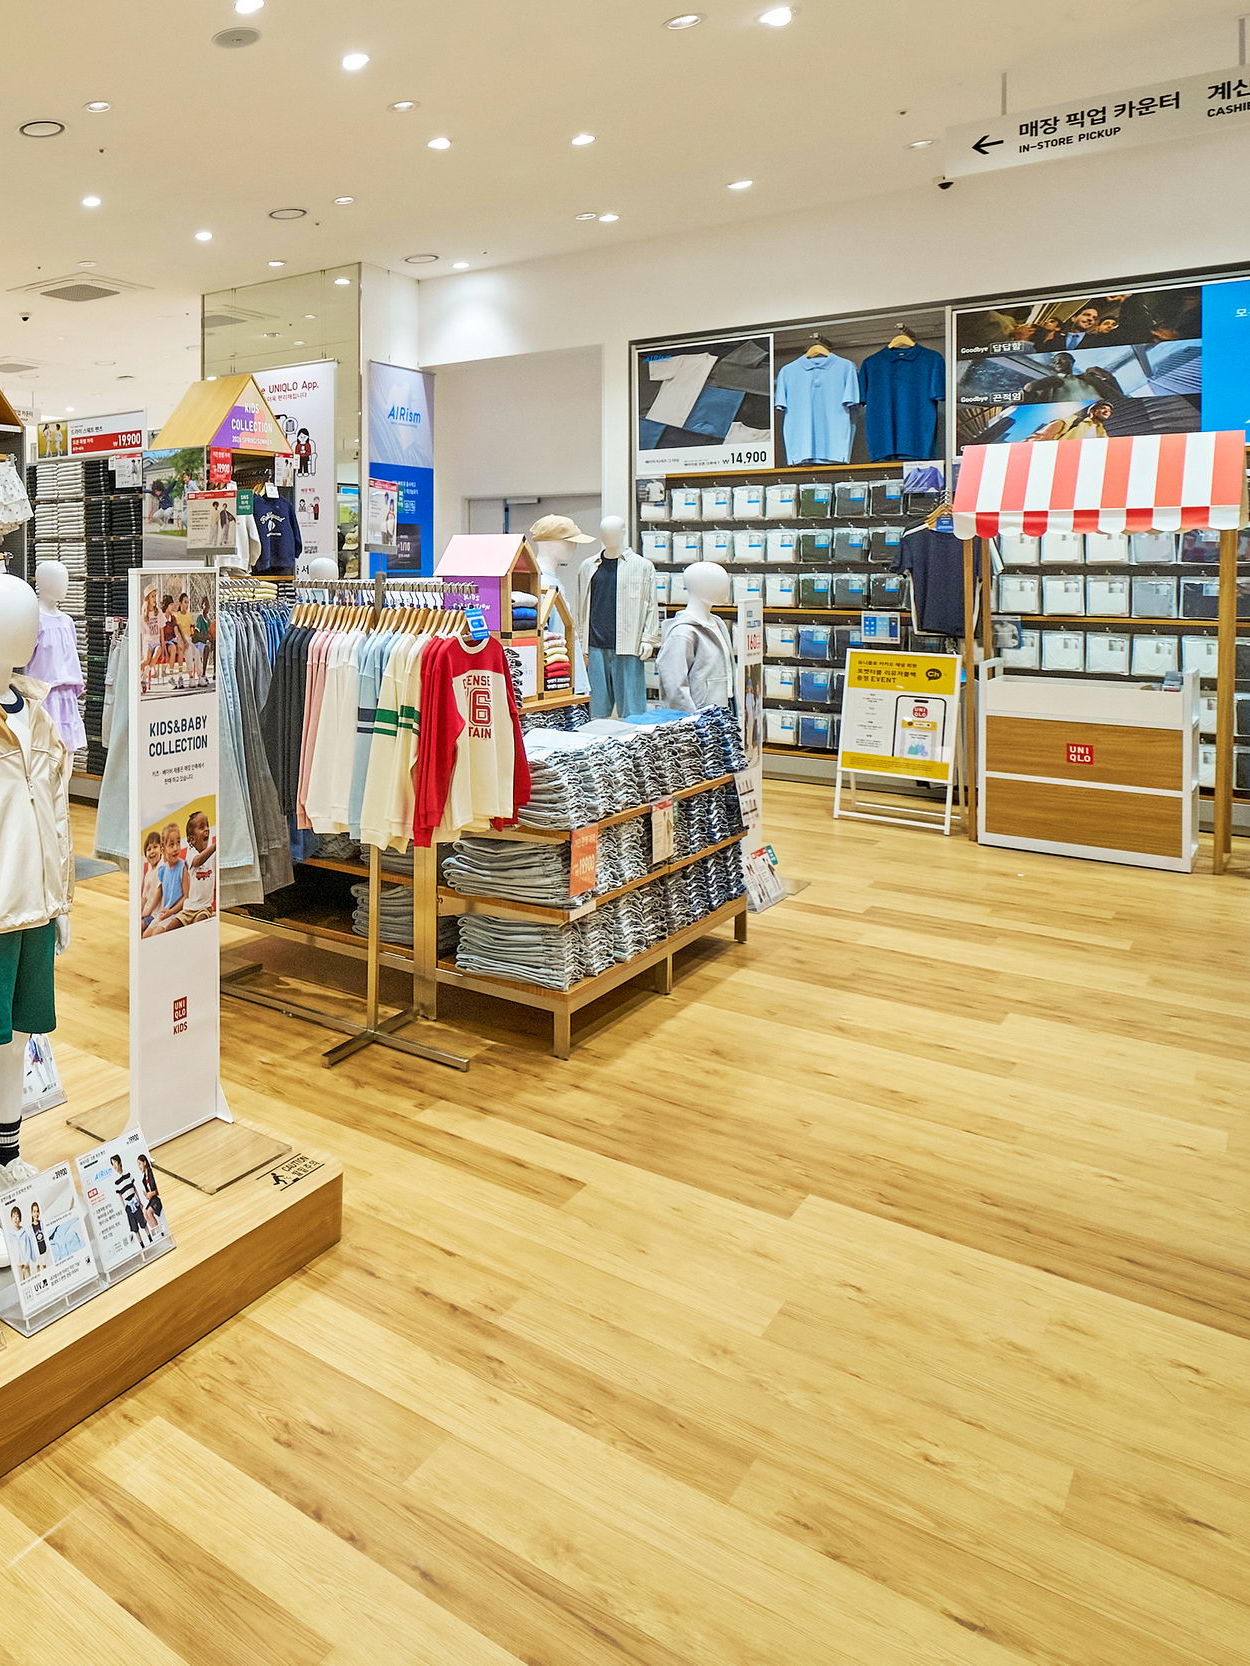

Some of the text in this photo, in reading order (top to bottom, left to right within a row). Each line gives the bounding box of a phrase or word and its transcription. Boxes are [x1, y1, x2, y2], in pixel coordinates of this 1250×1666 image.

[1019, 91, 1180, 137] 매장 픽업 카운터
[1019, 127, 1121, 153] IN-STORE PICKUP
[961, 346, 989, 354] Goodbye
[268, 380, 319, 394] UNIQLO App.
[961, 395, 989, 403] Goodbye
[244, 403, 259, 414] KIDS
[388, 406, 421, 424] AIRism
[231, 419, 272, 433] COLLECTION
[871, 676, 897, 684] EVENT
[150, 715, 208, 738] KIDS&BABY
[149, 735, 208, 758] COLLECTION
[1069, 745, 1091, 754] UNI
[1068, 753, 1092, 763] QLO
[174, 999, 186, 1010] UNI
[174, 1008, 186, 1019] QLO
[173, 1021, 188, 1036] KIDS
[282, 1155, 309, 1172] CAUTION
